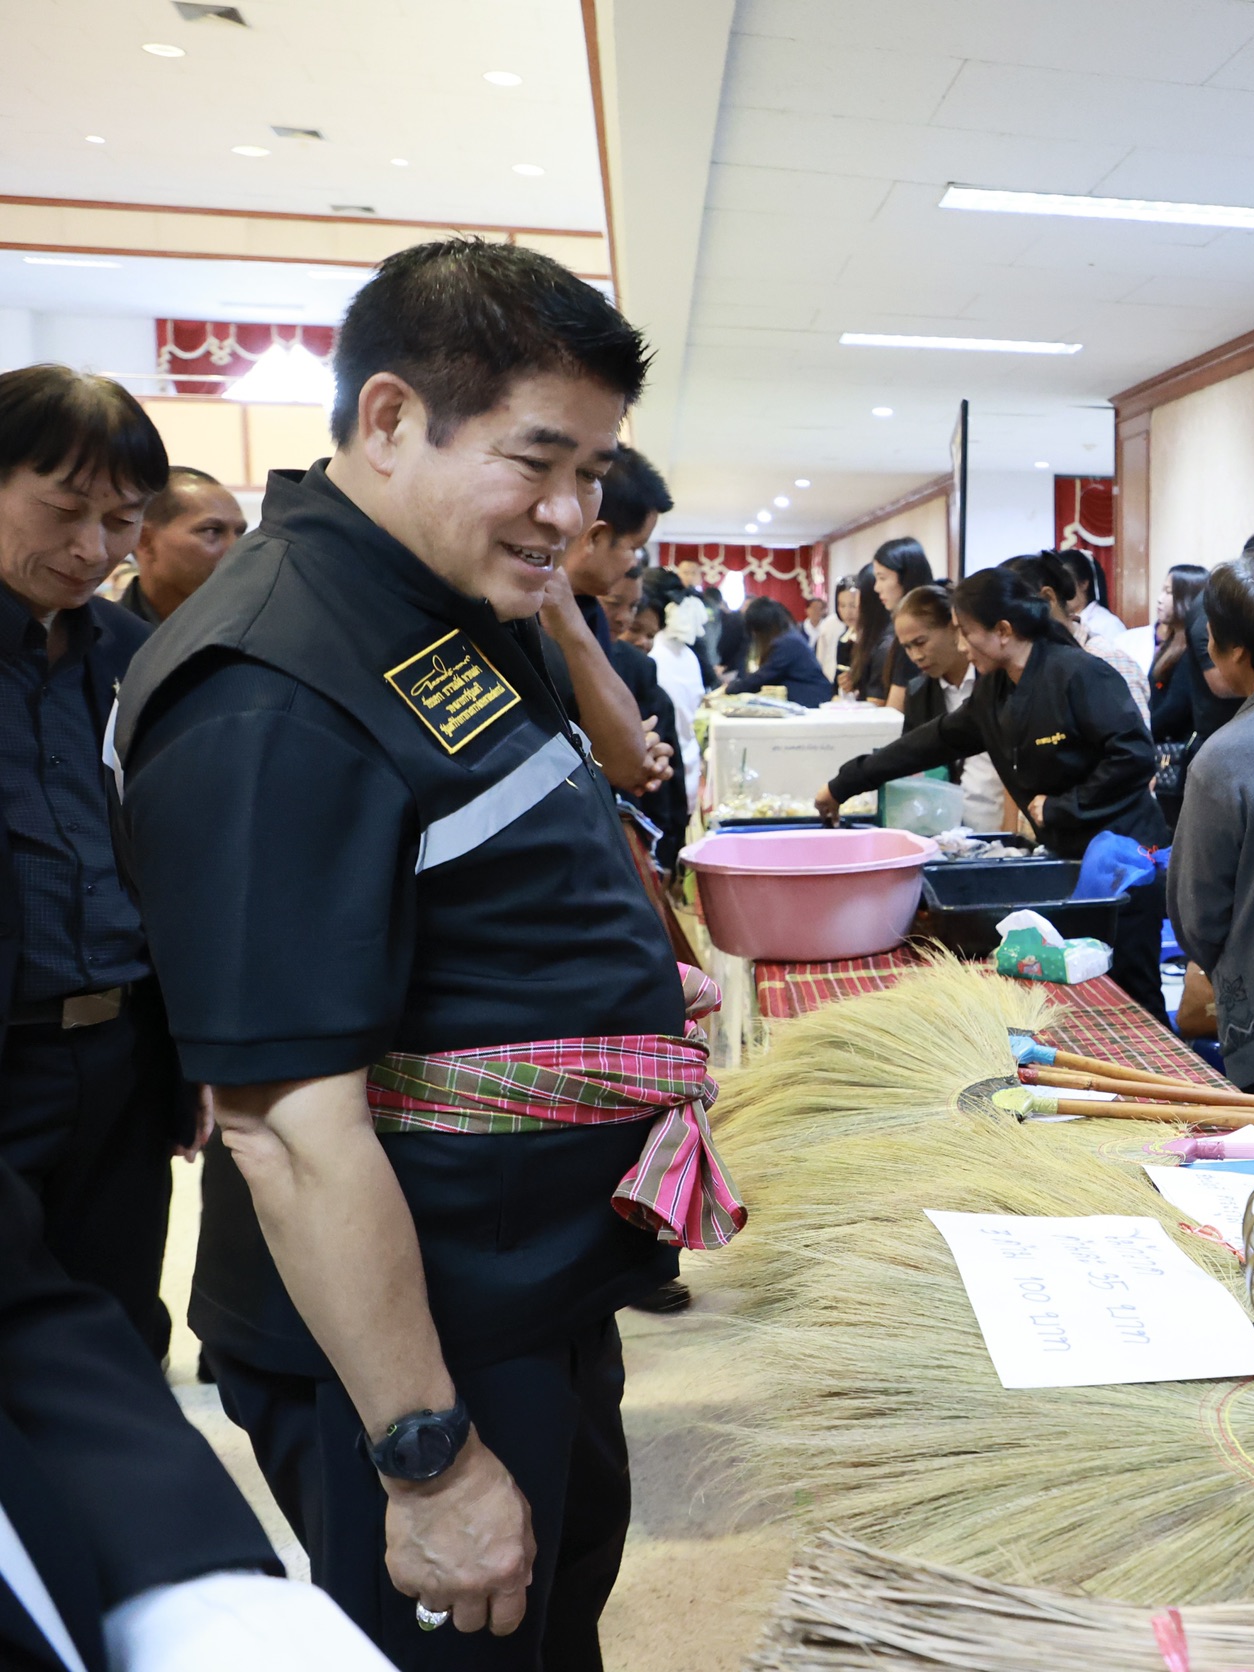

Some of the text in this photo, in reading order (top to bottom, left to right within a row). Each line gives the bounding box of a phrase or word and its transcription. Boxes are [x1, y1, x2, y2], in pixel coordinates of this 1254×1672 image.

[1013, 1276, 1052, 1303] 100
[1088, 1271, 1129, 1292] 35
[1029, 1312, 1072, 1352] บาท
[1106, 1304, 1151, 1345] บาท
